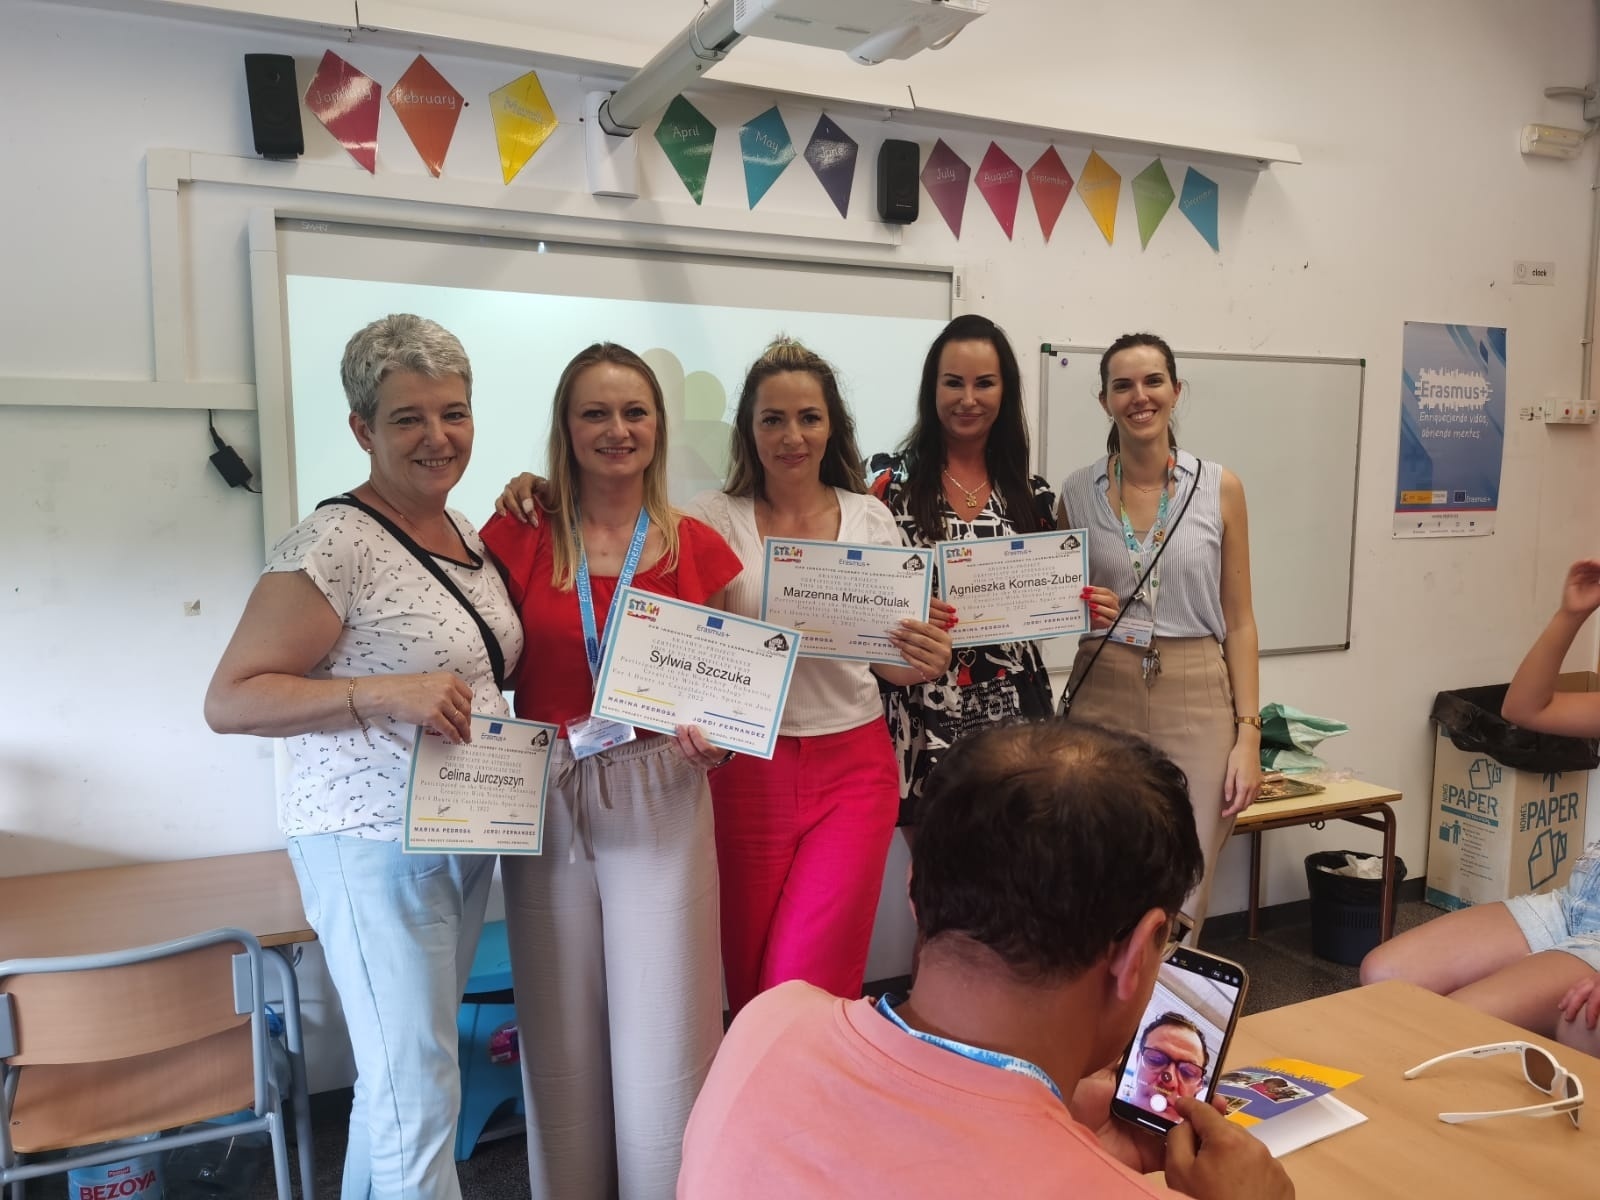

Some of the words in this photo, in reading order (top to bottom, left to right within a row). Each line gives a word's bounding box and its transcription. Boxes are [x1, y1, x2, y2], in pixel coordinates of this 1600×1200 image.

[396, 90, 456, 109] February
[672, 125, 700, 142] April
[755, 131, 779, 154] May
[935, 167, 956, 183] July
[983, 169, 1015, 184] August
[1031, 171, 1069, 187] September
[1421, 380, 1488, 400] Erasmus+
[1454, 426, 1480, 439] mentes
[629, 530, 647, 567] mentes
[949, 580, 1005, 598] Agnieszka
[1009, 572, 1082, 589] Kornas-Zuber
[627, 596, 660, 616] STEAM
[783, 586, 838, 601] Marzenna
[842, 592, 909, 607] Mruk-Otulak
[696, 624, 731, 638] Erasmus+
[648, 649, 693, 674] Sylwia
[695, 661, 752, 686] Szczuka
[607, 695, 638, 707] MARINA
[692, 716, 715, 726] JORDI
[718, 723, 765, 739] FERNANDEZ
[438, 766, 471, 781] Celina
[473, 770, 524, 788] Jurczyszyn
[1448, 785, 1498, 817] PAPER
[1527, 792, 1579, 830] PAPER
[80, 1170, 157, 1200] BEZOYA
